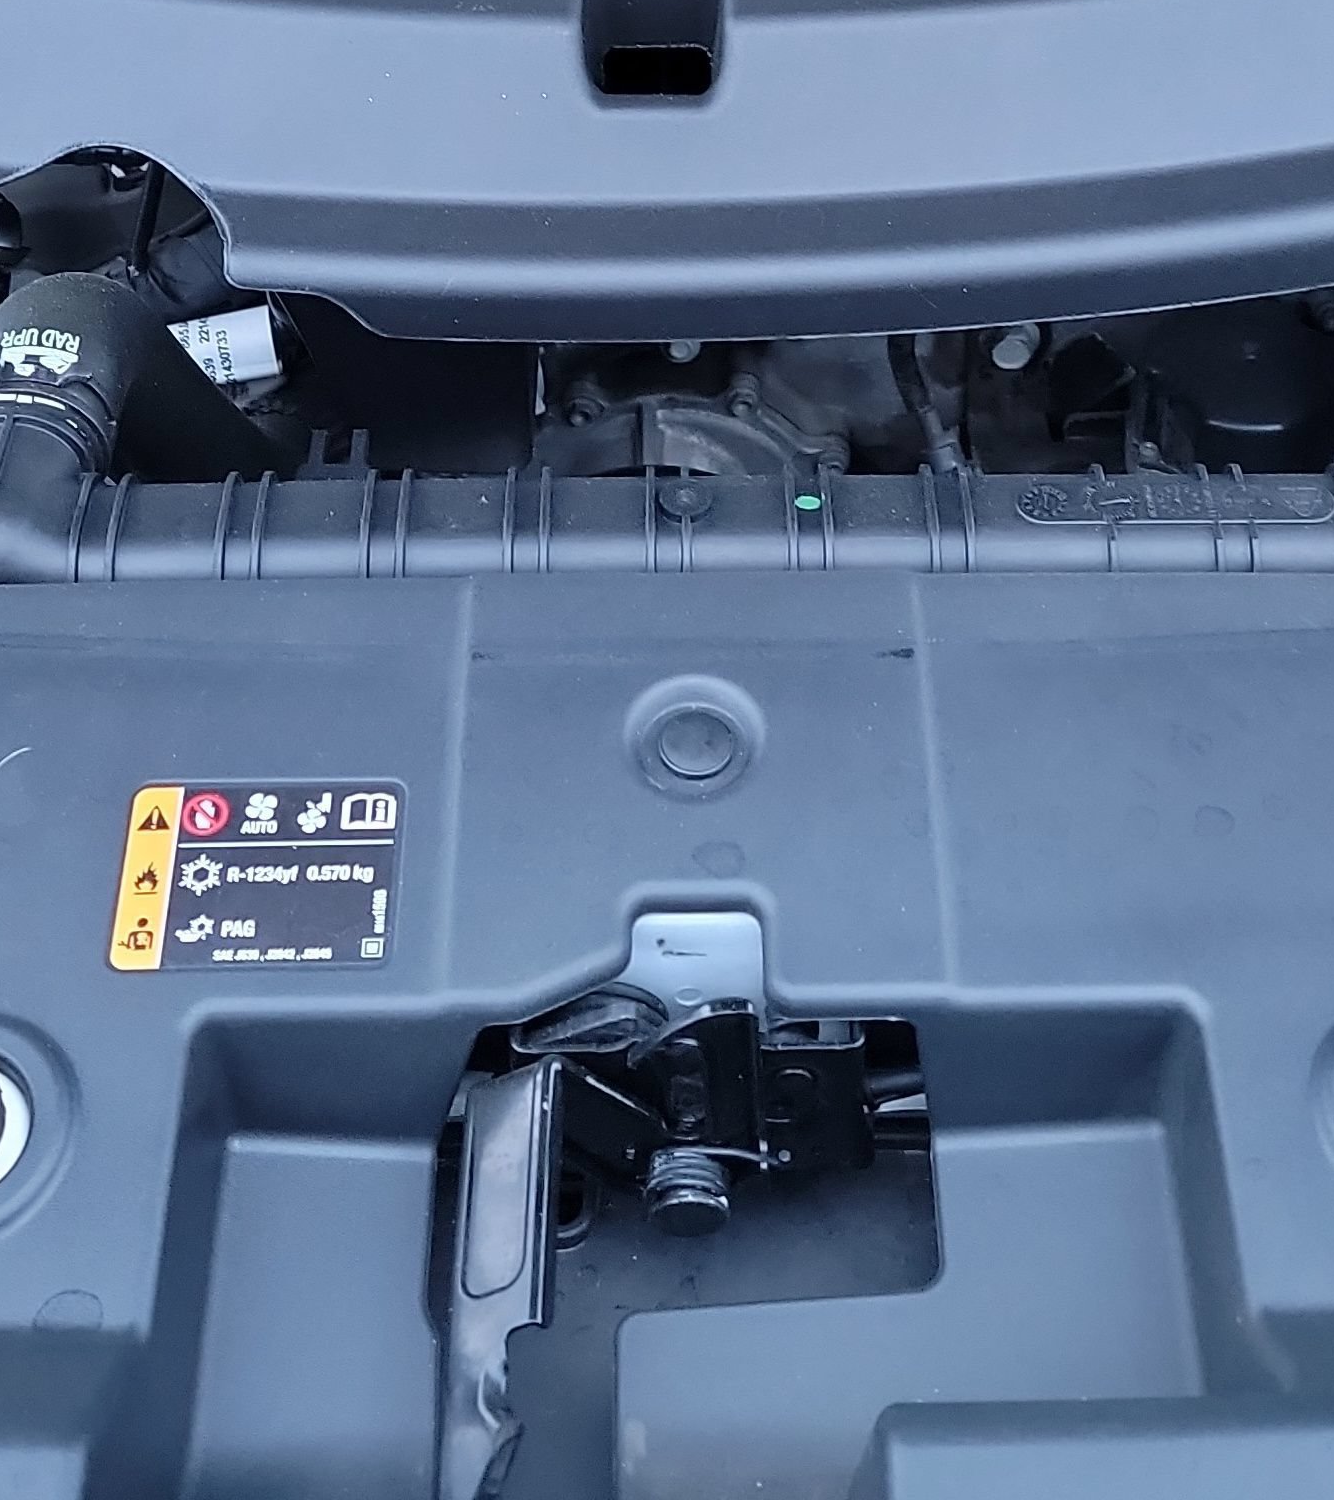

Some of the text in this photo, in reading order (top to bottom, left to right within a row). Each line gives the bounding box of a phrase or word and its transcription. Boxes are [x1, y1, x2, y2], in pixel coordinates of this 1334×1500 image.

[0, 327, 81, 354] RAD UPR
[240, 820, 278, 834] AUTO
[226, 863, 375, 884] R-1234yf 0.570 kg
[220, 919, 256, 938] PAG
